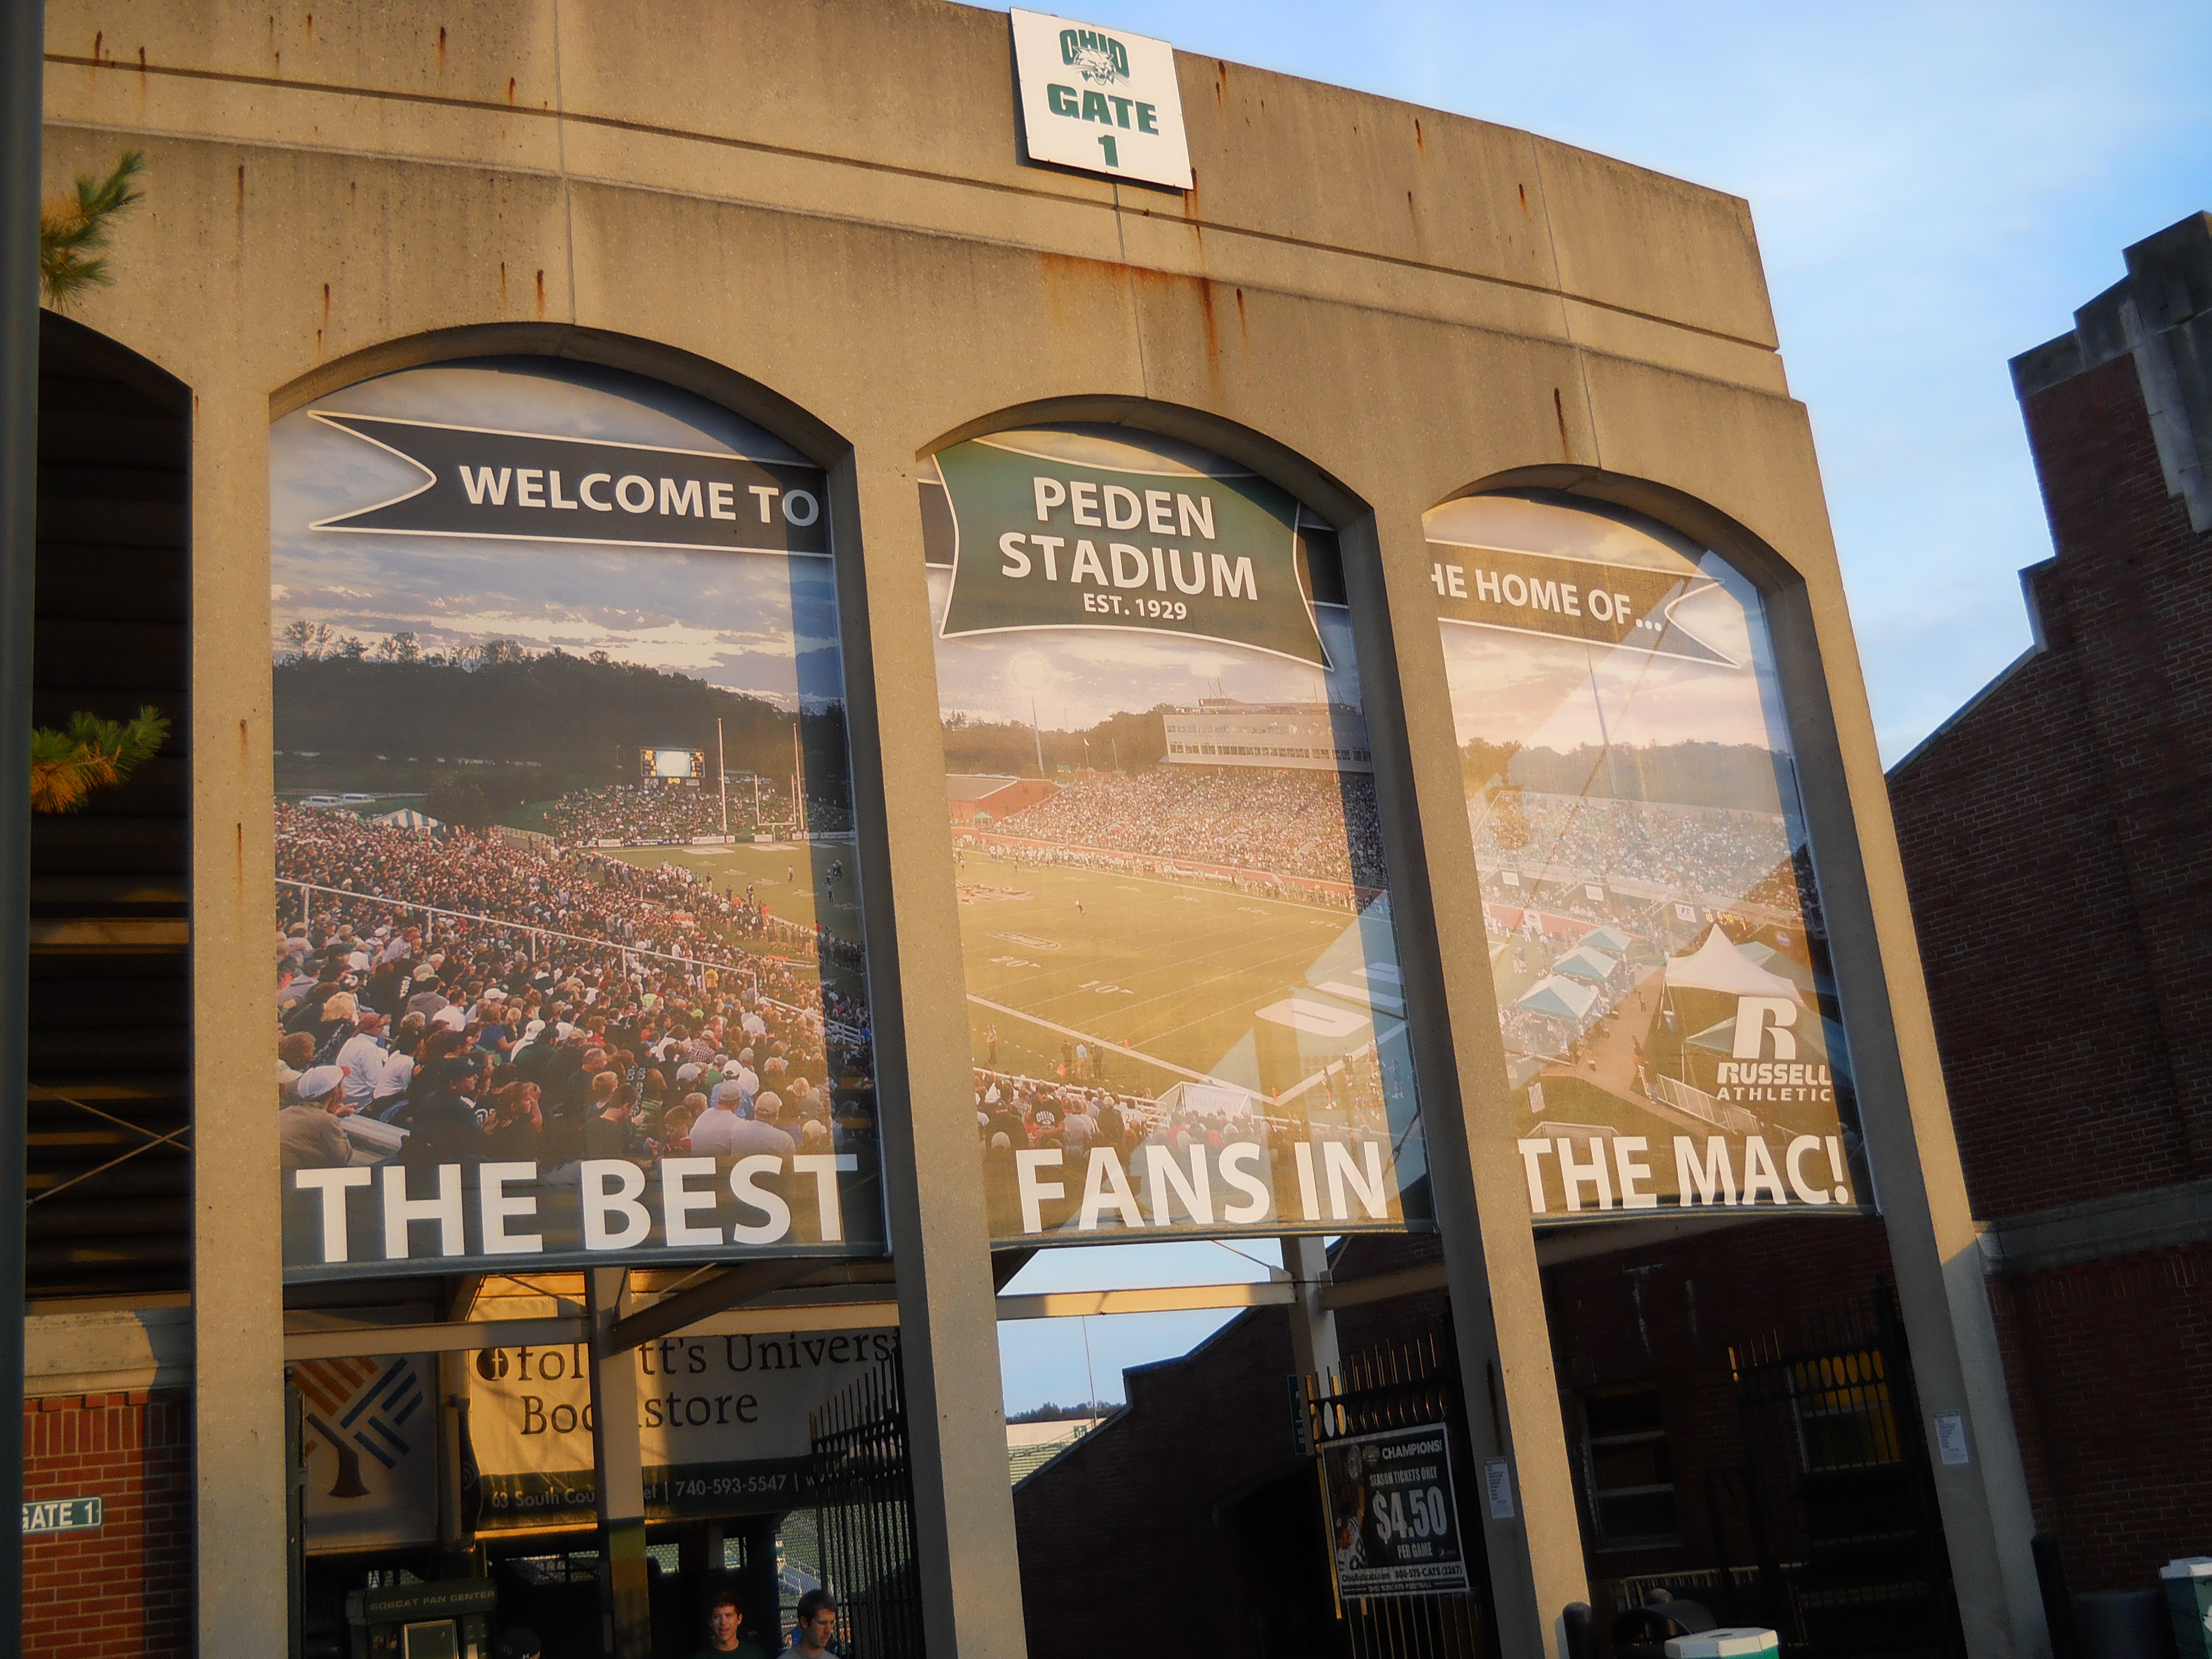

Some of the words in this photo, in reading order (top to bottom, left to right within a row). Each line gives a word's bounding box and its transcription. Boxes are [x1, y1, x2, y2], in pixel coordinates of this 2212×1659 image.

[1047, 83, 1159, 136] GATE
[1097, 135, 1119, 168] 1
[459, 465, 737, 521] WELCOME
[749, 485, 819, 526] TO
[1033, 477, 1215, 540] PEDEN
[999, 532, 1258, 601] STADIUM
[1083, 593, 1130, 615] EST.
[1135, 599, 1187, 620] 1929
[1431, 563, 1467, 598] HE
[1475, 569, 1581, 616] HOME
[1732, 996, 1797, 1059] R
[1716, 1087, 1831, 1101] ATHLETIC
[1717, 1062, 1831, 1086] RUSSELL
[1015, 1142, 1270, 1234] FANS
[1294, 1141, 1388, 1221] IN
[1518, 1135, 1657, 1213] THE
[1673, 1134, 1849, 1207] MAC!
[296, 1161, 543, 1263] THE
[580, 1154, 858, 1250] BEST
[517, 1337, 707, 1381] foltt's
[521, 1391, 758, 1435] Bostore
[1382, 1439, 1443, 1460] CHAMPIONS!
[492, 1491, 509, 1508] 63
[515, 1486, 560, 1507] South
[564, 1488, 595, 1504] Cou
[676, 1474, 787, 1497] 740-593-5547
[1370, 1471, 1394, 1486] SEASON
[1394, 1467, 1420, 1484] TICKETS
[1420, 1465, 1438, 1481] ONLY
[85, 1501, 93, 1524] 1
[1373, 1486, 1447, 1544] $4.50
[1397, 1544, 1411, 1559] PER
[1412, 1542, 1433, 1558] GAME
[369, 1599, 419, 1611] BOBCAT
[423, 1596, 446, 1605] FAN
[450, 1590, 495, 1602] CENTER
